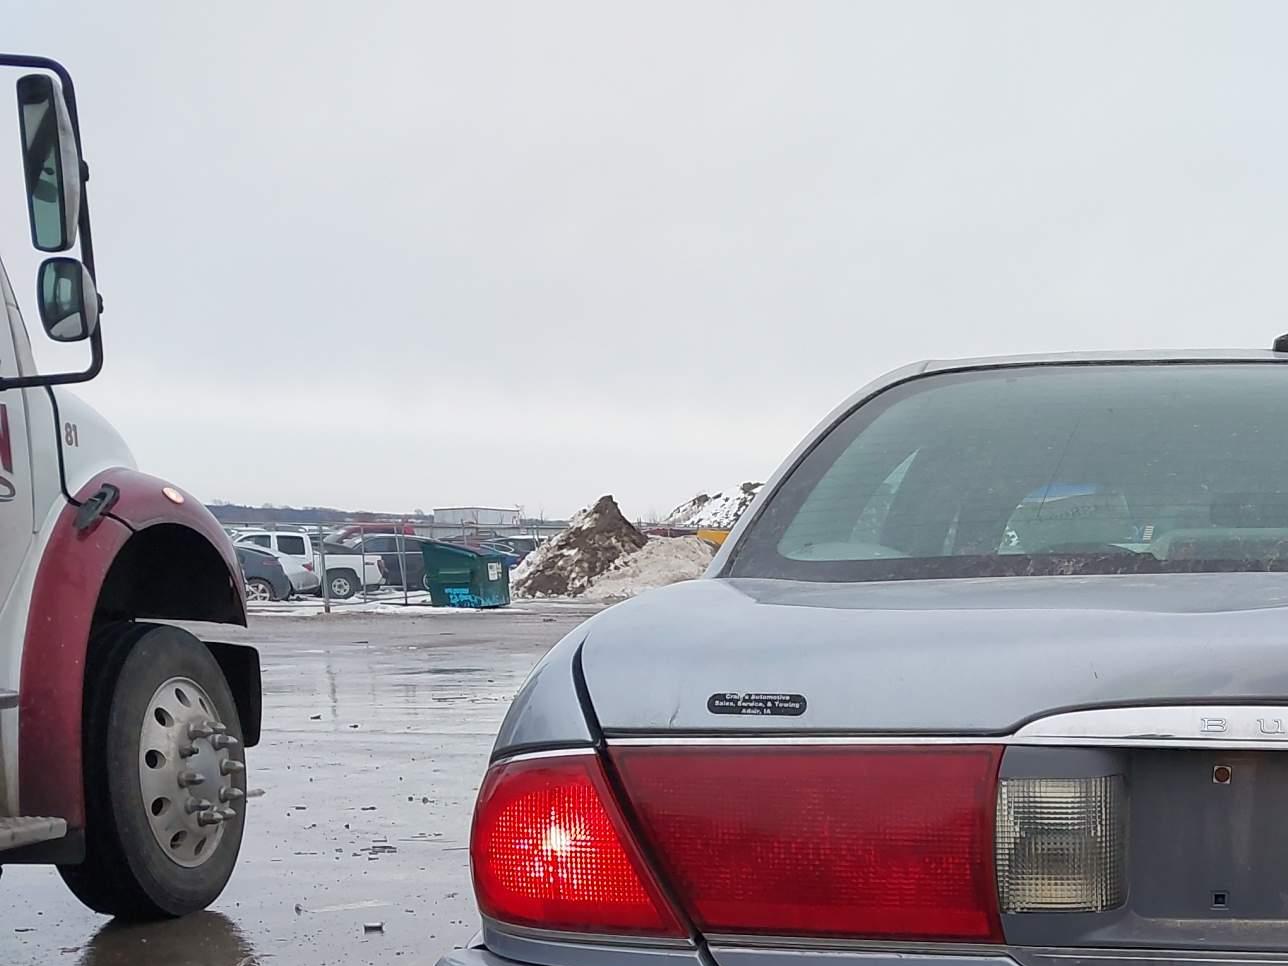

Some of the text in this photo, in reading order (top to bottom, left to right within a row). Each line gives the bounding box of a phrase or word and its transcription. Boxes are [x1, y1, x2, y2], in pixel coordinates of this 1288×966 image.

[64, 422, 79, 447] 81
[750, 693, 790, 701] Automotive
[774, 701, 800, 709] Towing
